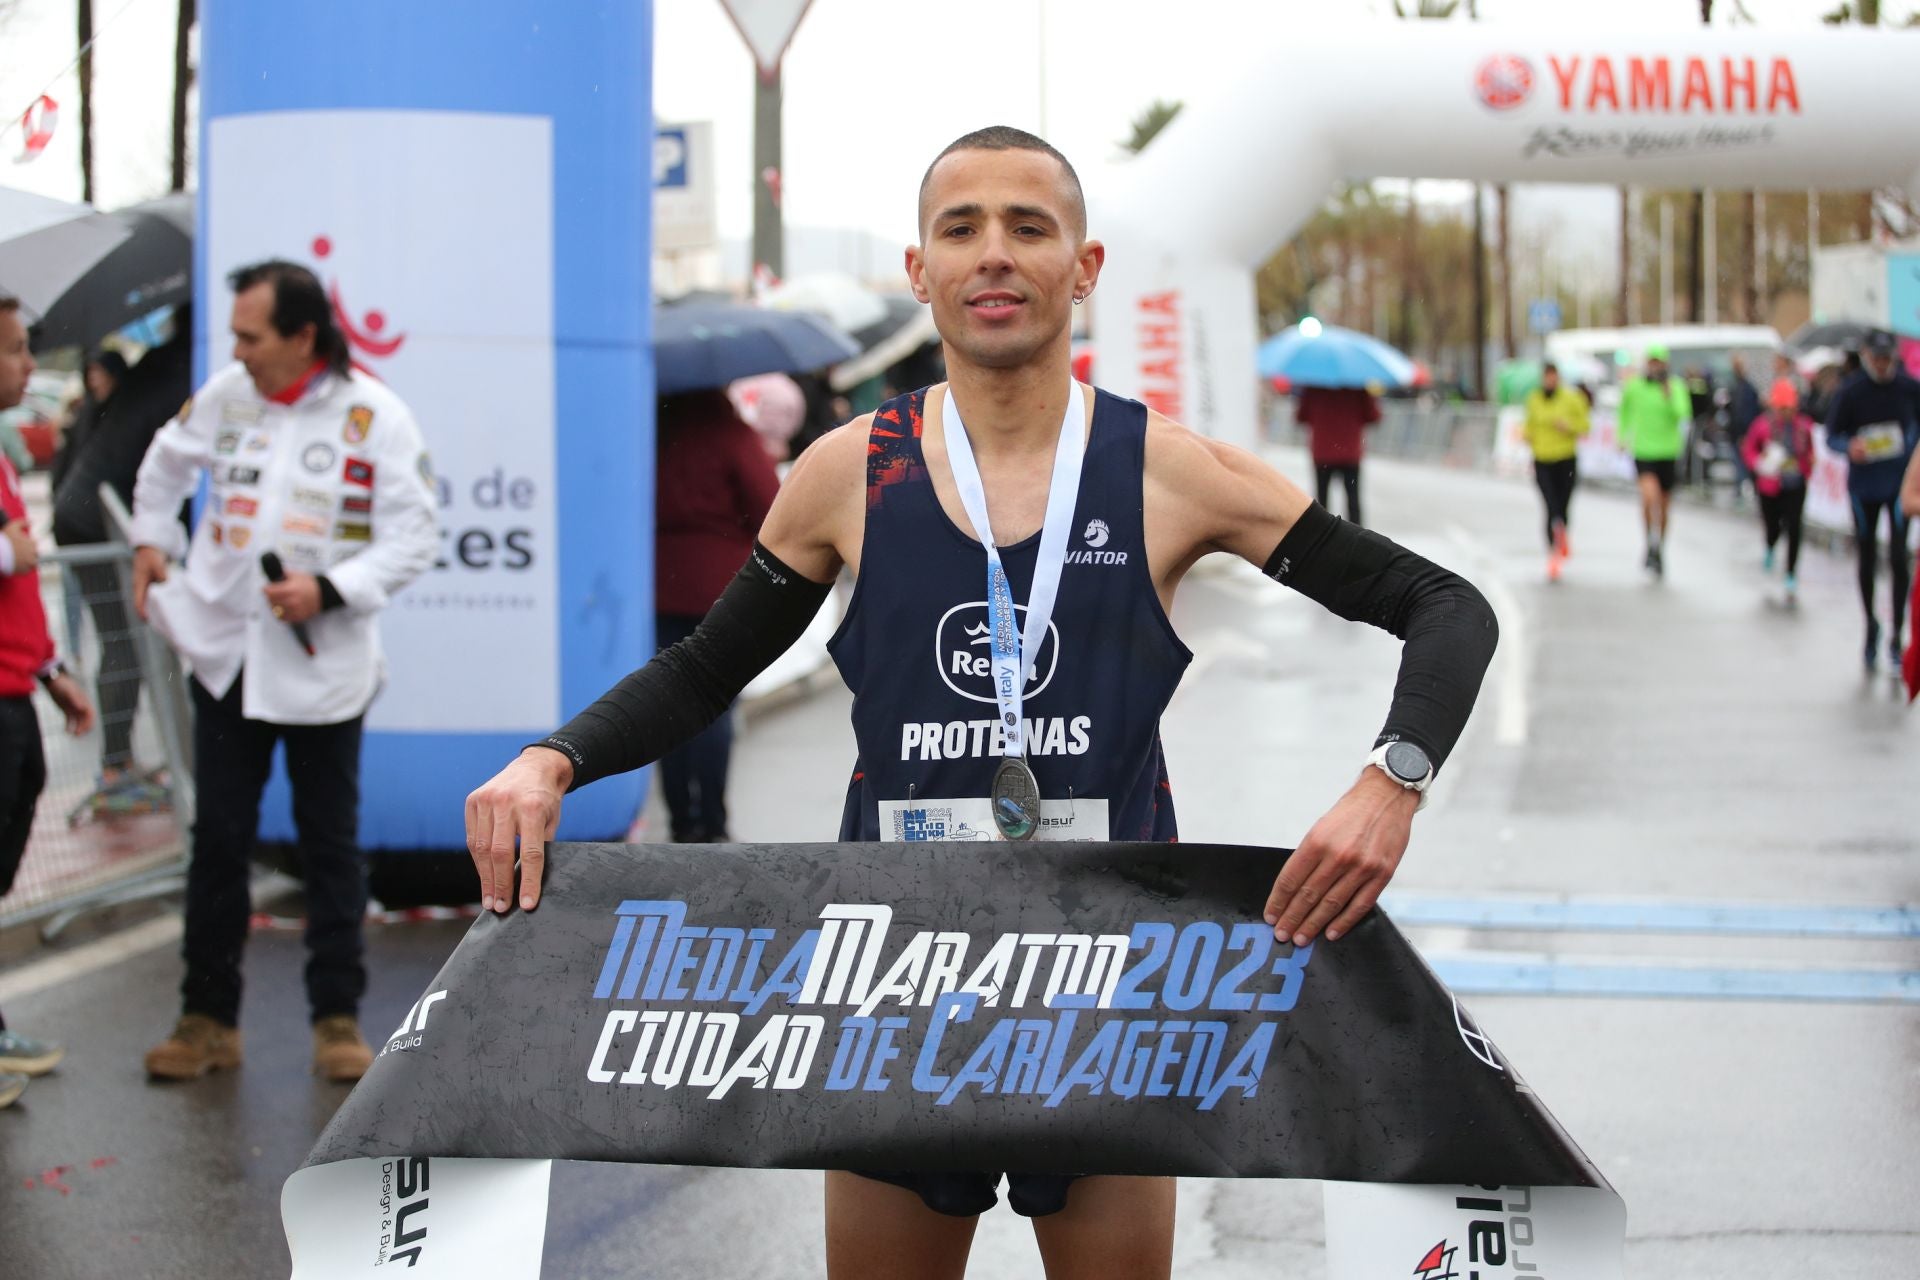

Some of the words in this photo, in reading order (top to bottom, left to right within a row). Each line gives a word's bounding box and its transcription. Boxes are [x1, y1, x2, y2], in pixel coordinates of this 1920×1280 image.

[1548, 56, 1801, 113] YAMAHA
[472, 466, 536, 509] de
[1000, 666, 1015, 707] vitaly
[901, 716, 1092, 761] PROTENAS
[593, 900, 822, 1016] MEDIA
[1111, 922, 1315, 1012] 2023
[391, 1034, 423, 1053] Build
[587, 1010, 825, 1100] CIUDAD
[824, 1016, 910, 1091] DE
[911, 992, 1278, 1110] CARTAGENA
[380, 1162, 393, 1215] Design
[382, 1219, 392, 1231] &
[375, 1234, 391, 1266] Build
